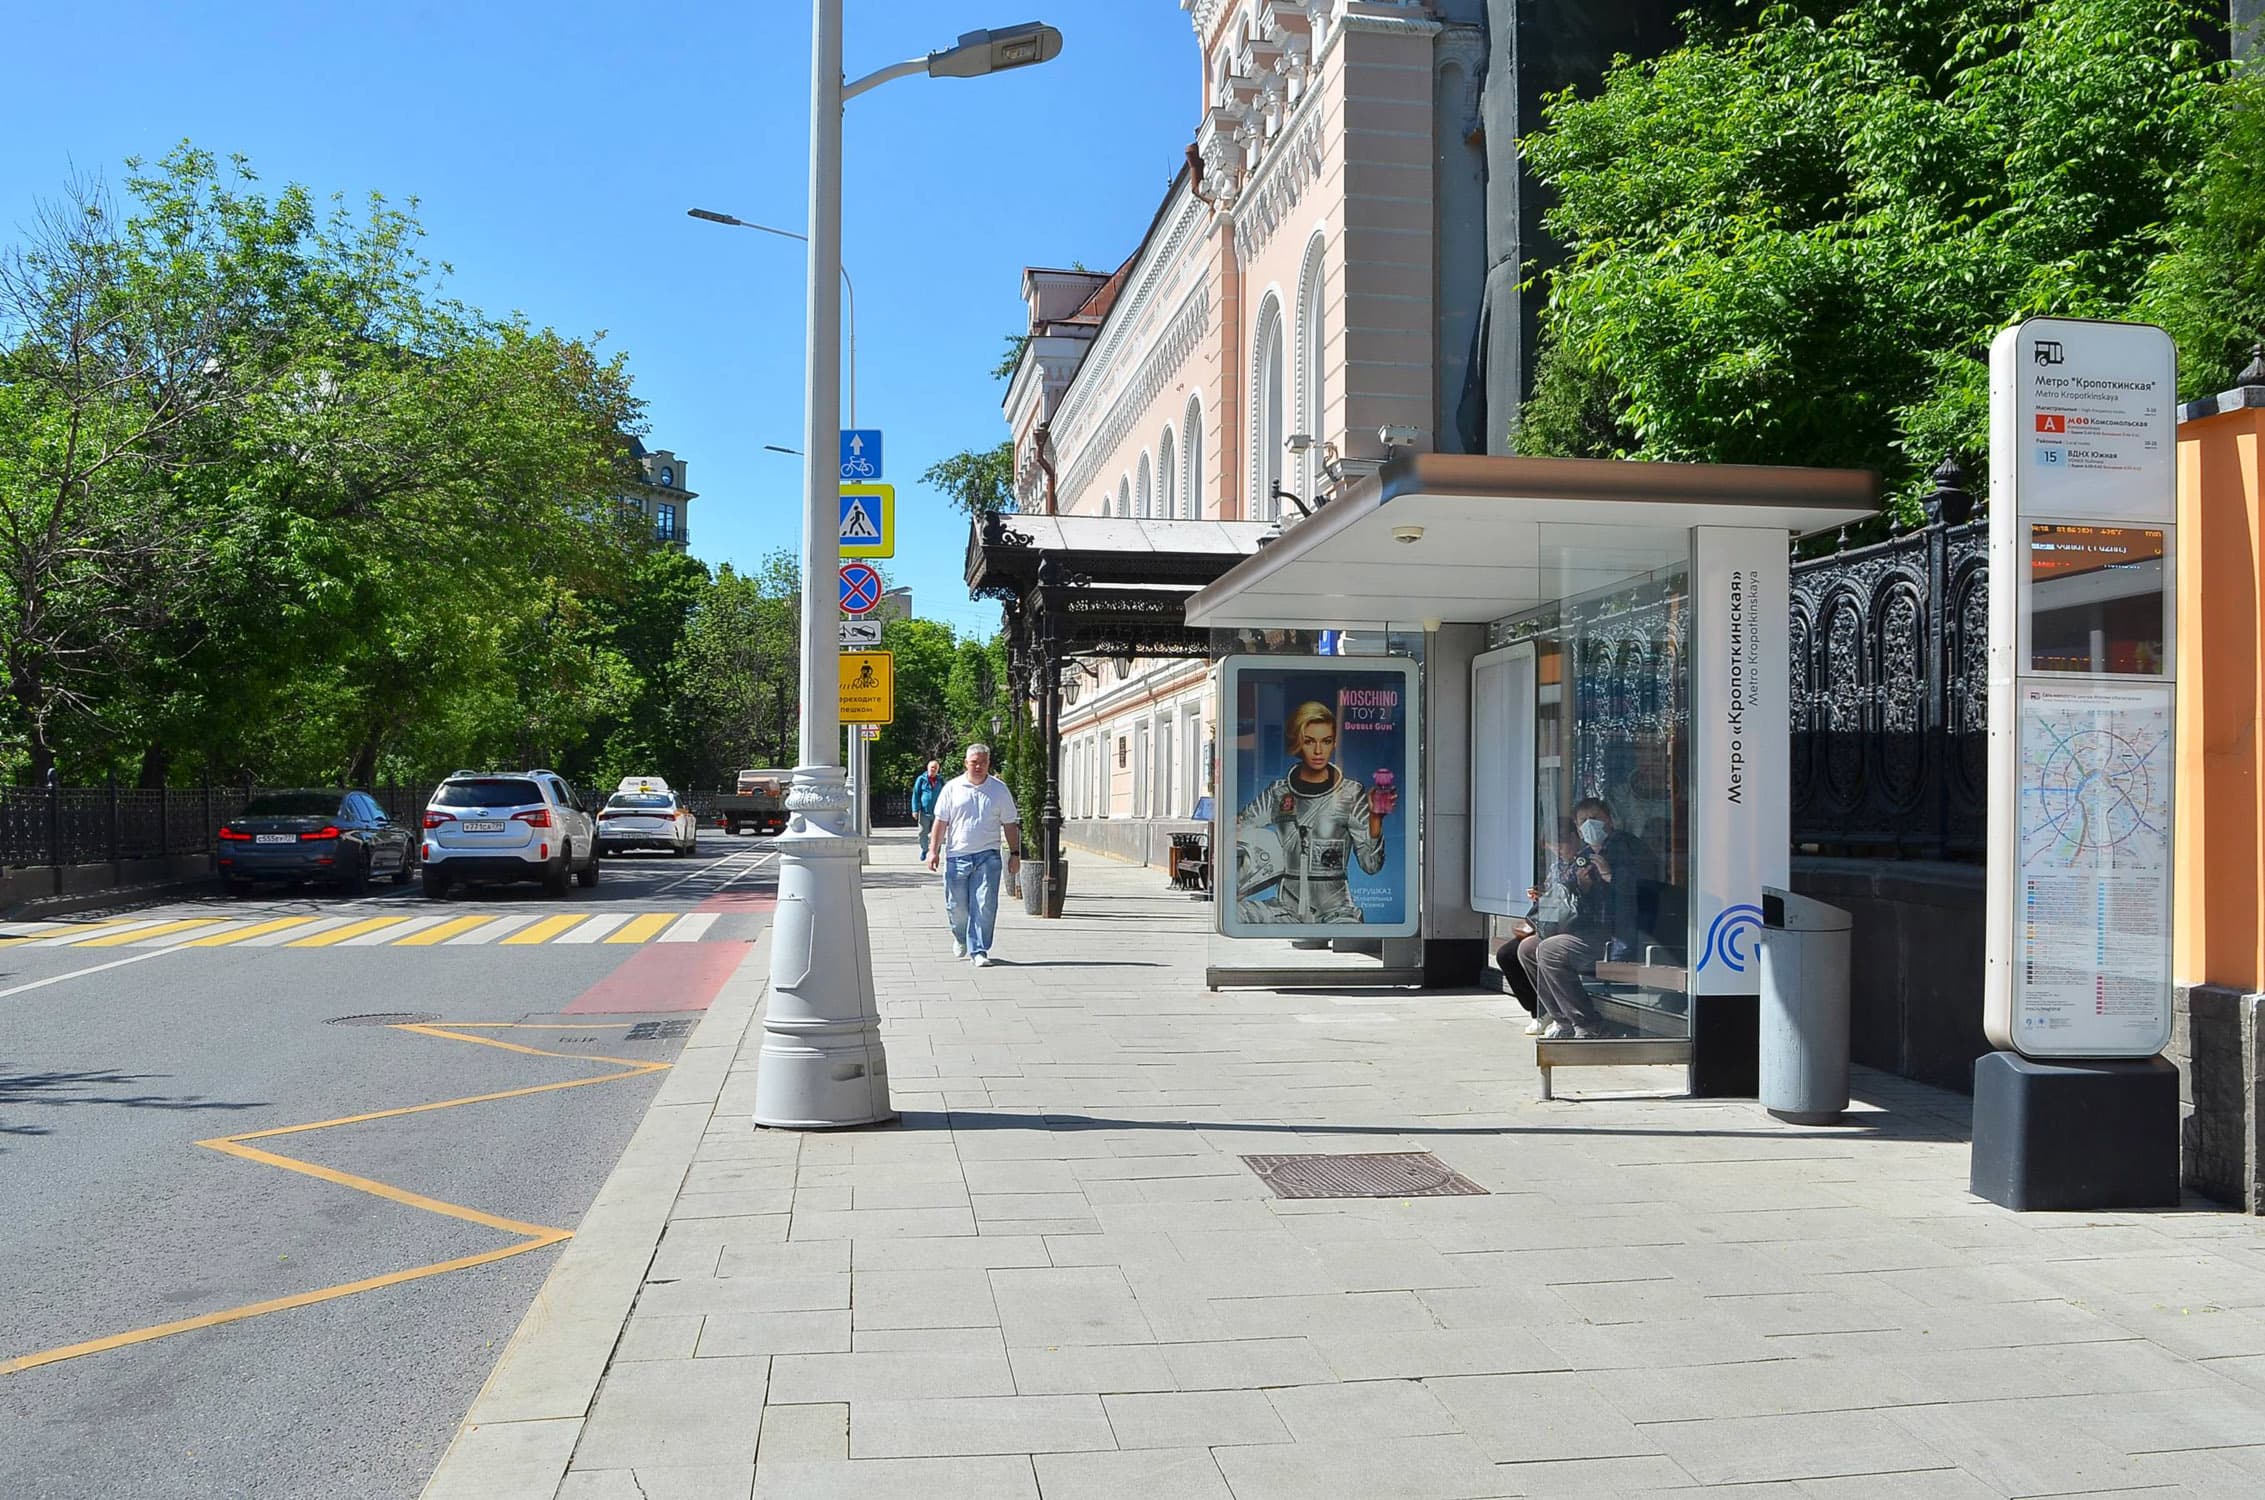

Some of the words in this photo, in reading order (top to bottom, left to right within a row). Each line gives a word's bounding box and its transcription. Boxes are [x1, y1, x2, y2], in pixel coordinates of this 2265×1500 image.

[2035, 376, 2069, 388] Метро
[2071, 377, 2156, 391] "Кропоткинская"
[2035, 390, 2059, 399] Metro
[2061, 391, 2119, 403] Kropotkinskaya
[2090, 418, 2148, 428] Комсомольская
[2044, 451, 2057, 463] 15
[2067, 450, 2090, 459] ВДНХ
[2091, 451, 2118, 459] Южная
[1749, 571, 1760, 665] Kropotkinskaya
[1728, 571, 1745, 735] «Кропоткинская»
[1748, 668, 1758, 706] Metro
[1339, 690, 1398, 706] MOSCHINO
[1351, 707, 1376, 720] TOY
[1379, 708, 1386, 720] 2
[1728, 740, 1745, 804] Метро
